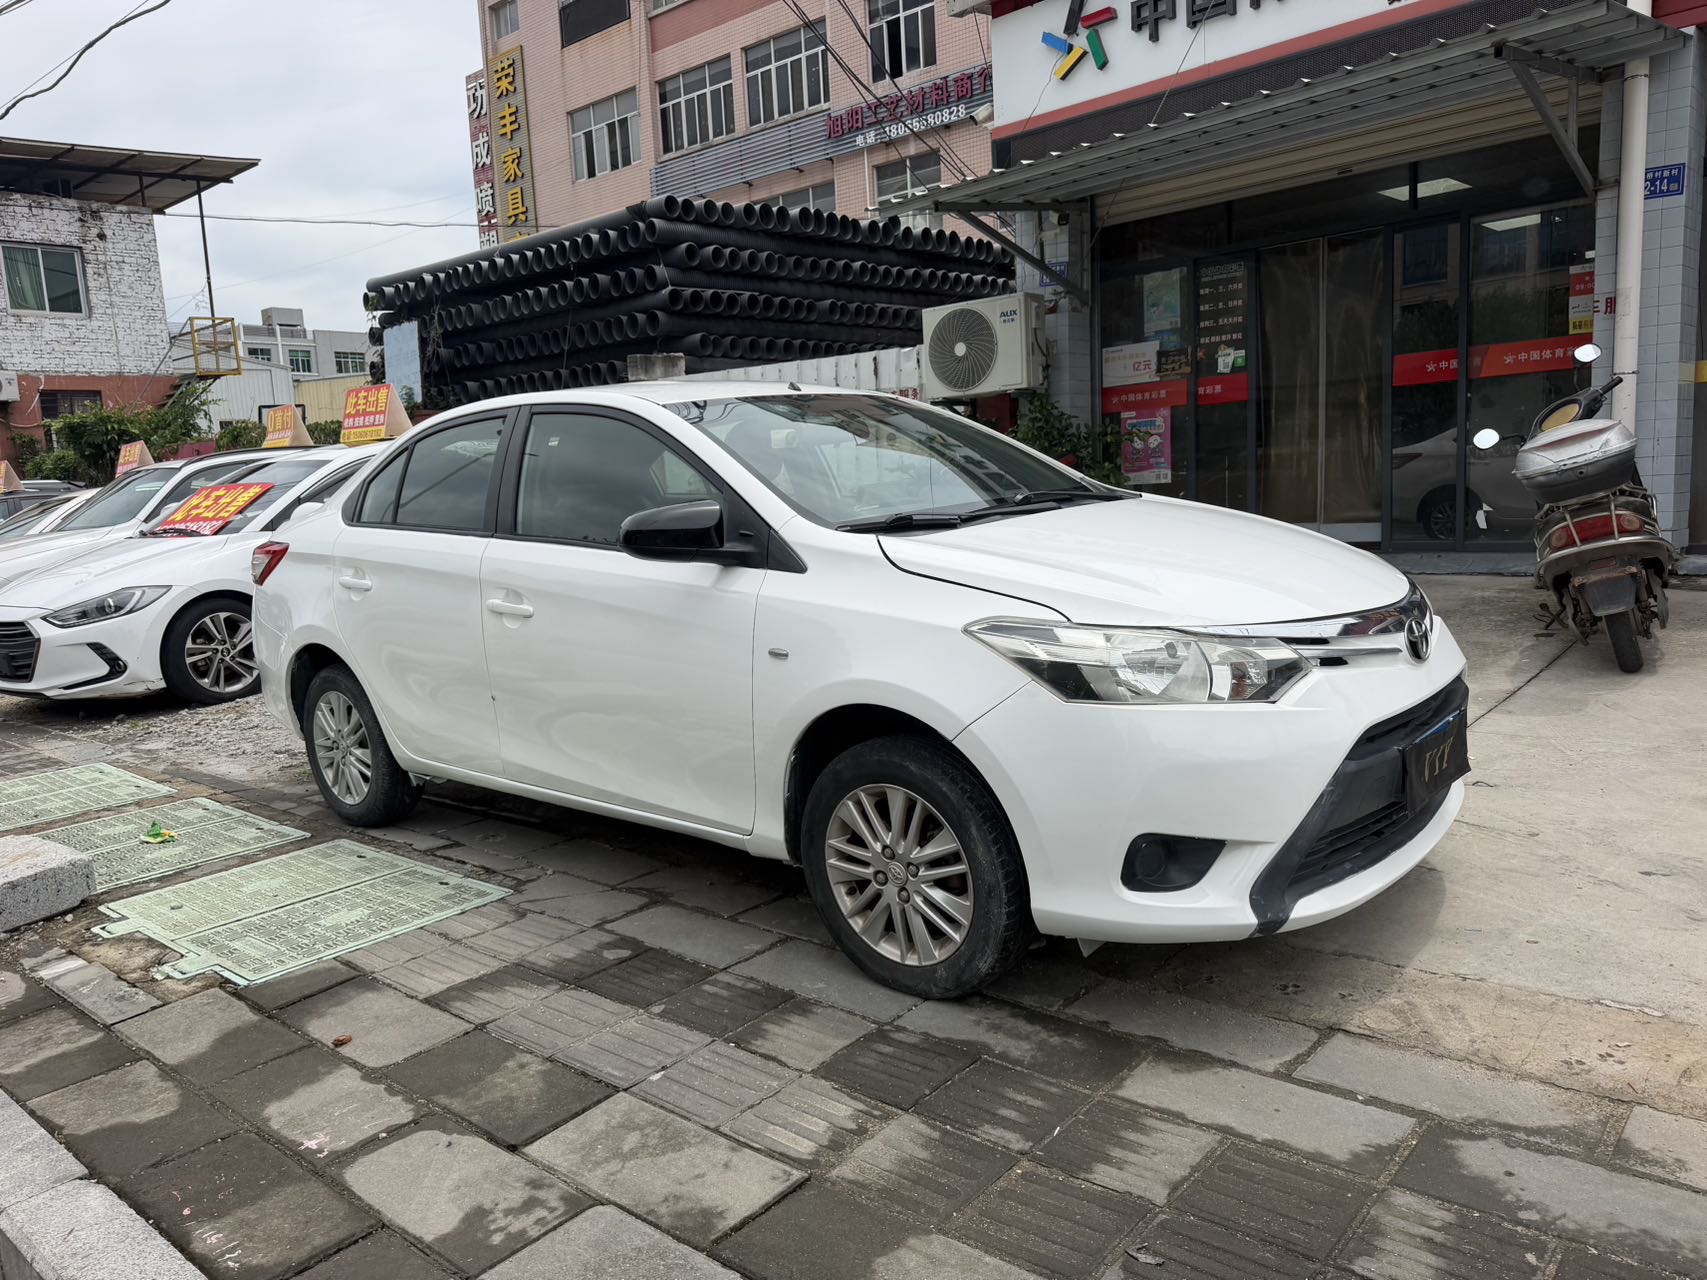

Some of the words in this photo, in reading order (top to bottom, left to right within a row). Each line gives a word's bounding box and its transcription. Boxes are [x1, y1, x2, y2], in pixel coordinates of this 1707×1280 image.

[494, 57, 530, 243] 荣丰家具
[1000, 309, 1018, 318] AUX
[1133, 360, 1153, 372] 亿元
[345, 387, 389, 415] 此车出售
[166, 484, 263, 522] 此车出售
